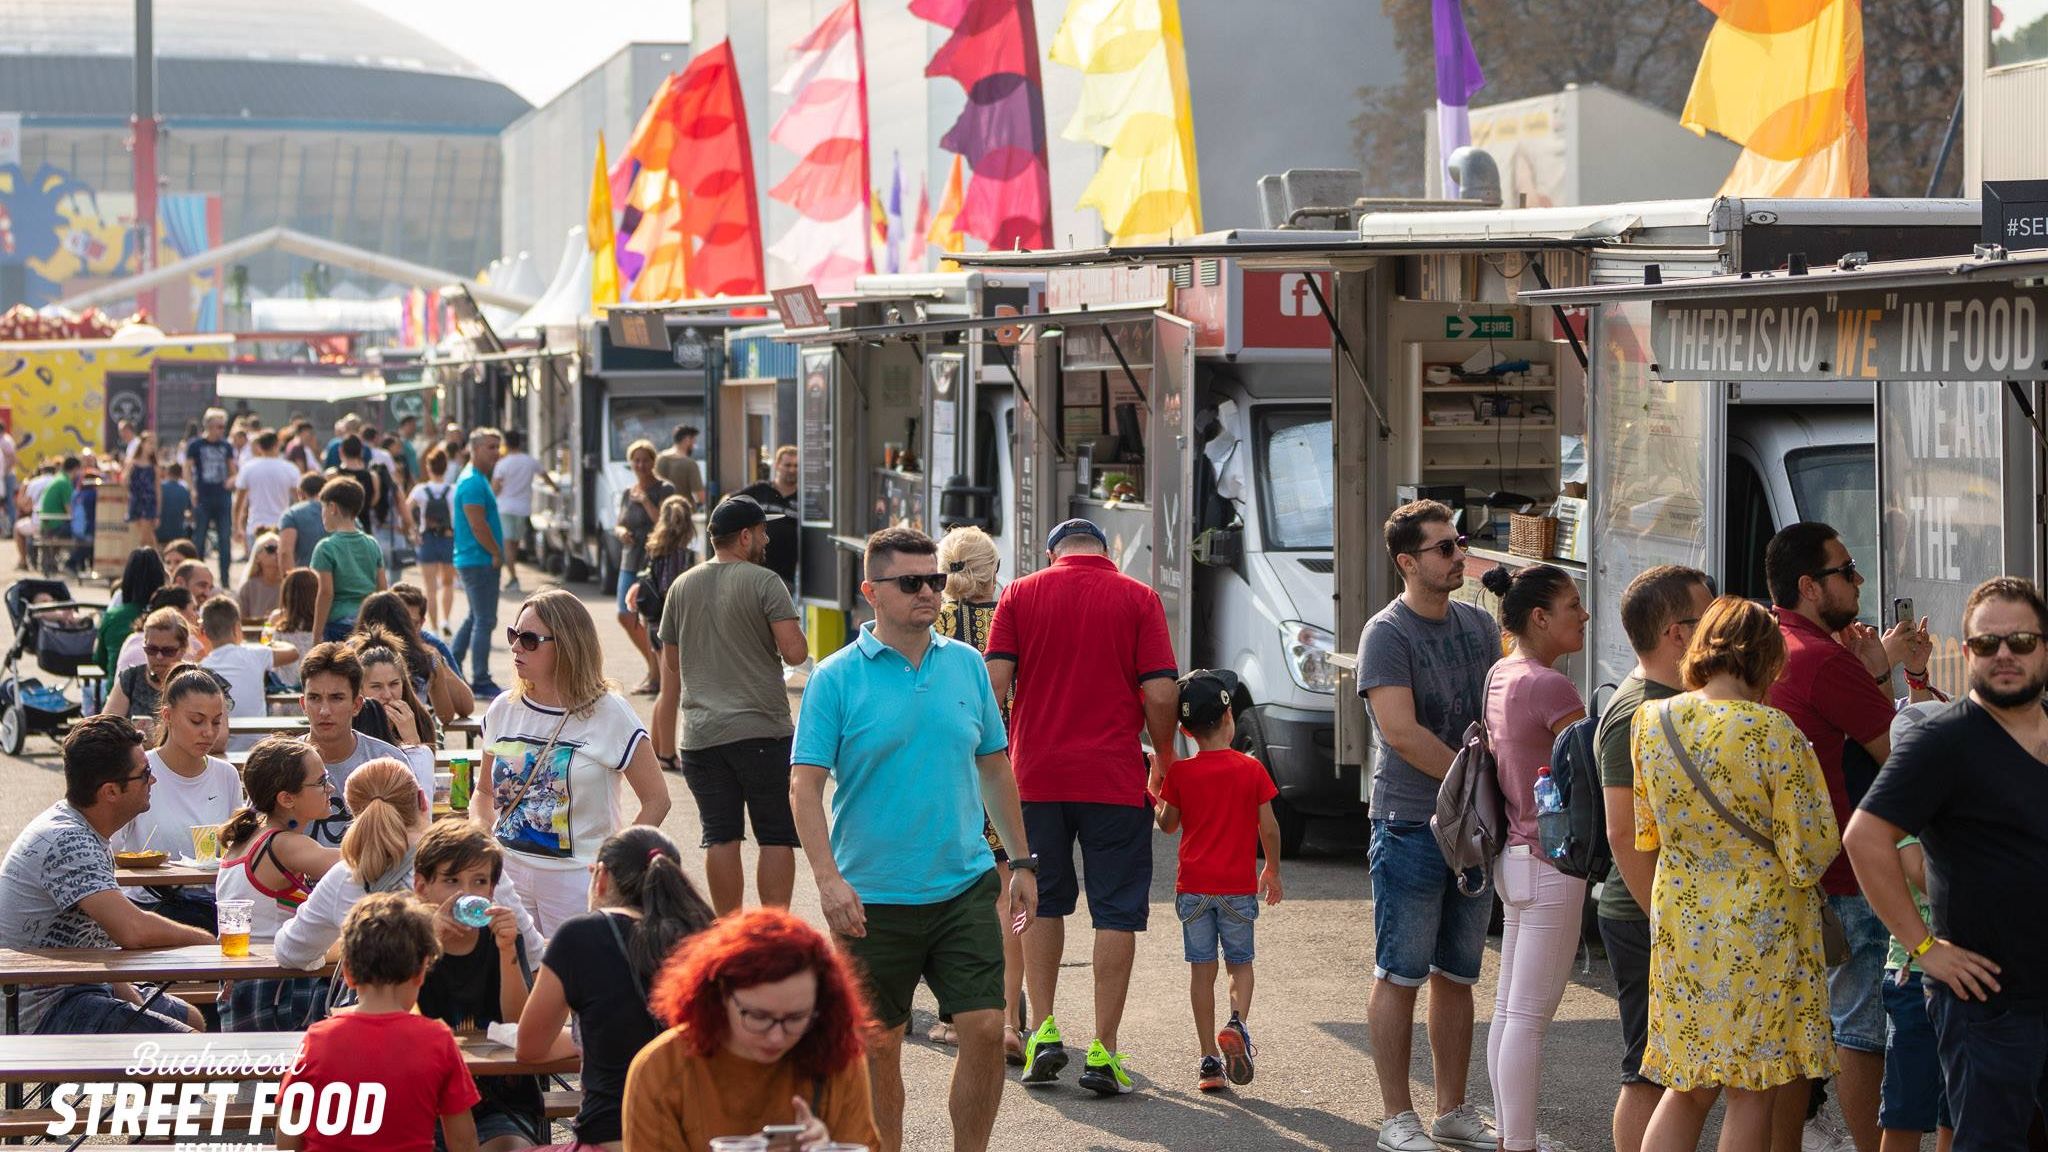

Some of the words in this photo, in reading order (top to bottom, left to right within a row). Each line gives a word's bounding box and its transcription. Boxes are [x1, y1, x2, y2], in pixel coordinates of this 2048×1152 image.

[1668, 308, 1746, 371] THERE
[1748, 307, 1775, 373] IS
[1777, 306, 1819, 373] NO
[1900, 301, 1934, 373] IN
[1942, 296, 2036, 373] FOOD
[1908, 496, 1961, 581] THE
